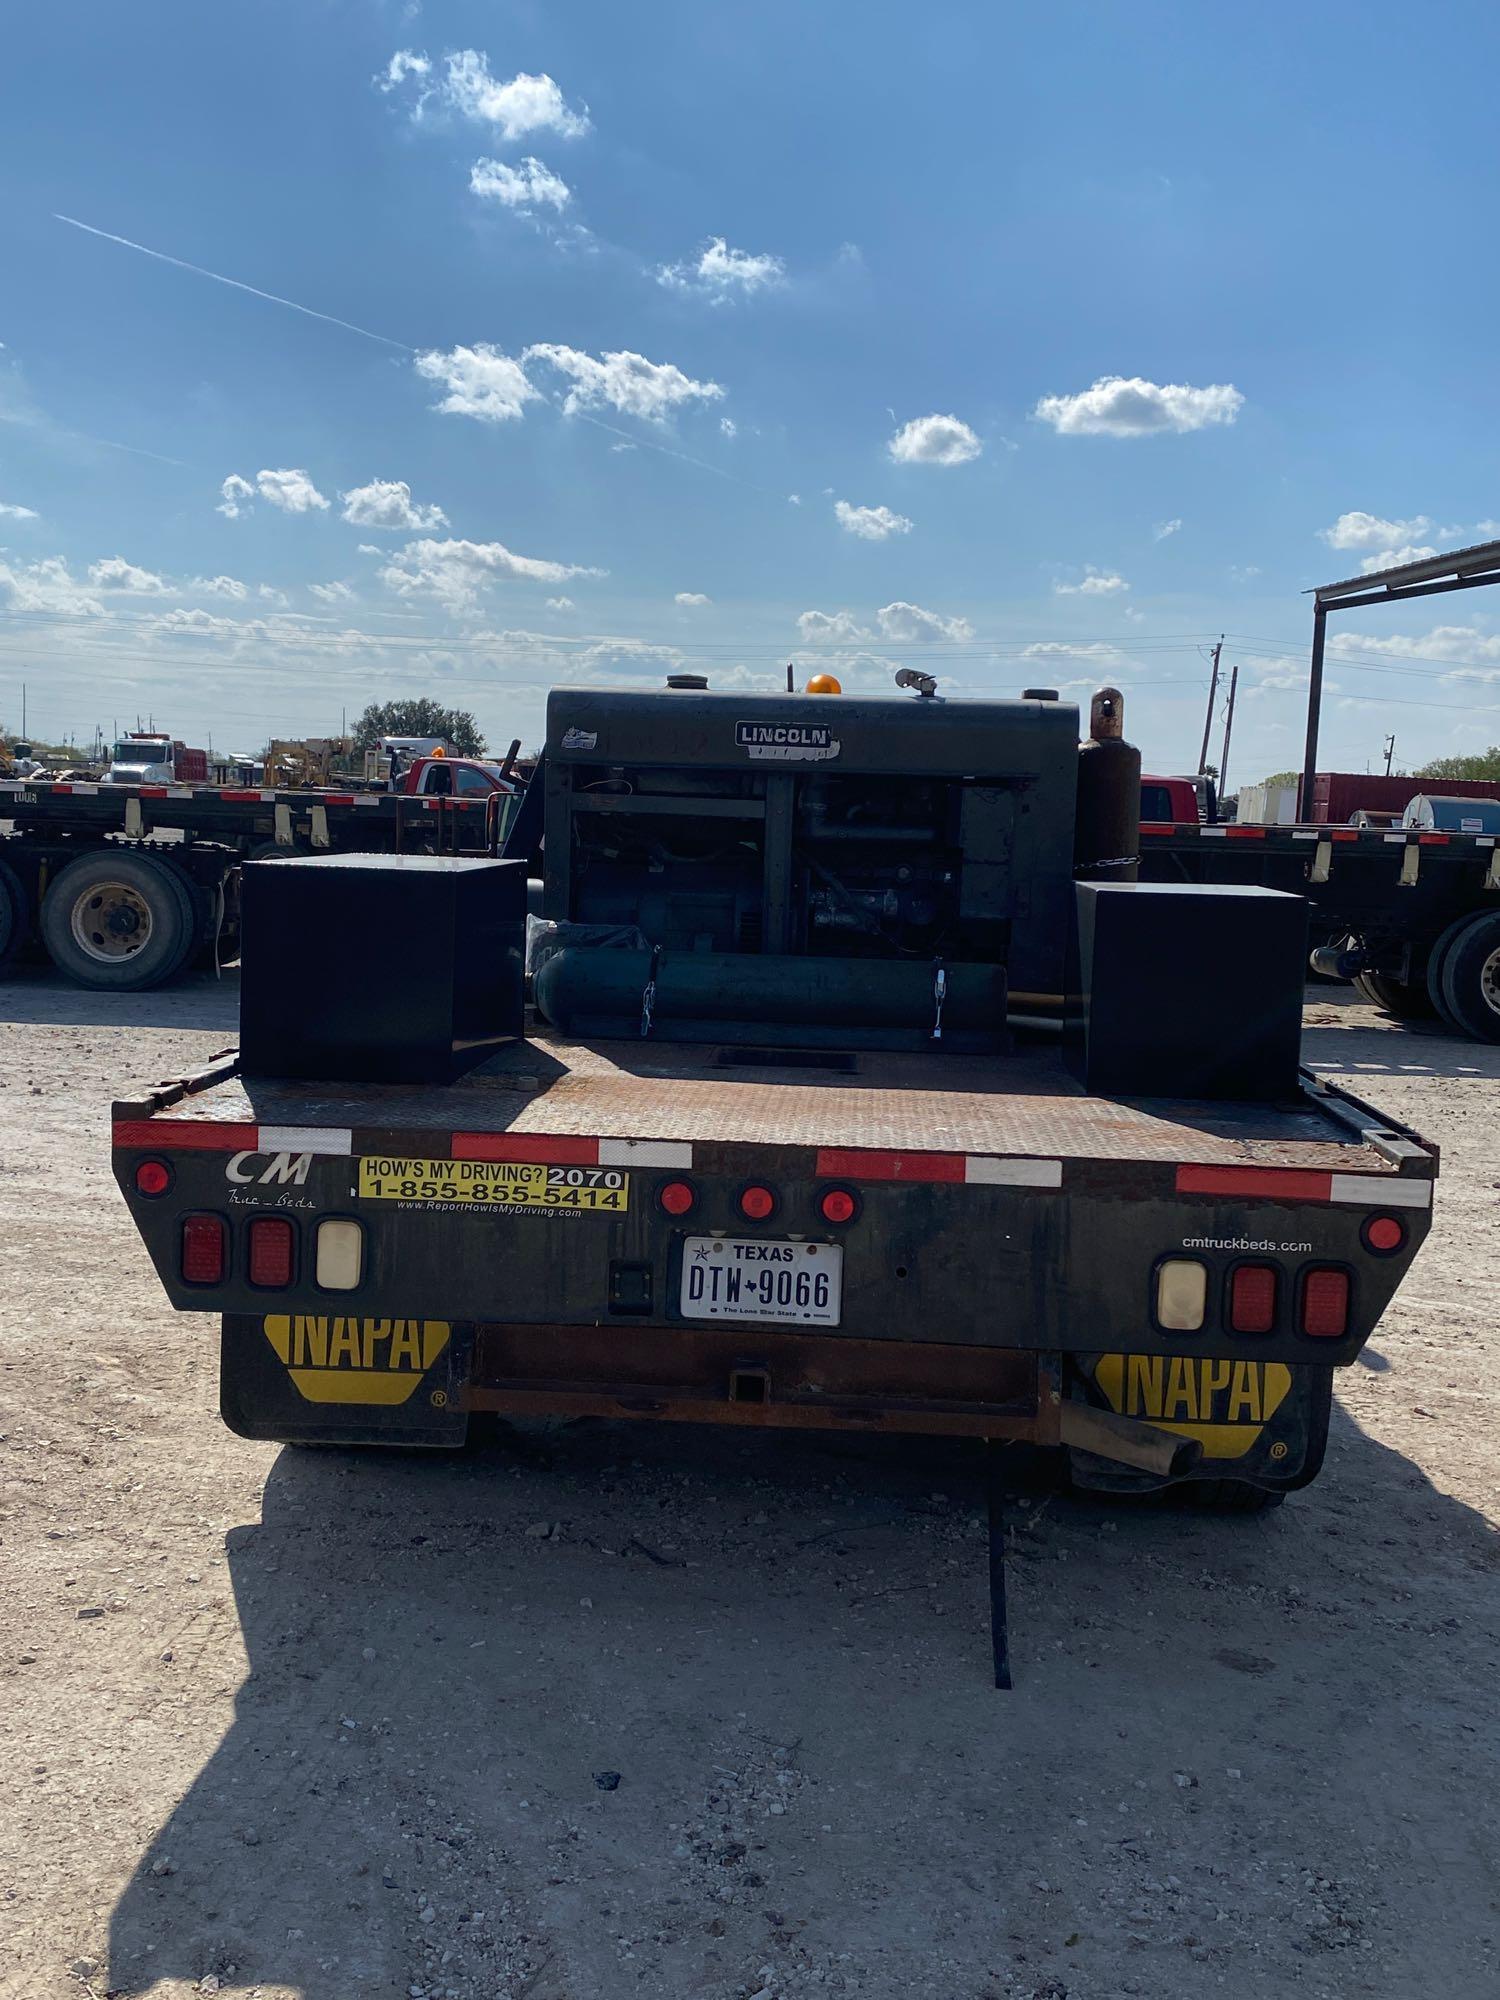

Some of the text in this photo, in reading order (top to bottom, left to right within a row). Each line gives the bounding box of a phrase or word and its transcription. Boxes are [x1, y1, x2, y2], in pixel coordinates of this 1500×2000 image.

[741, 727, 827, 744] LINCOLN
[225, 1150, 314, 1185] CM
[366, 1159, 543, 1183] HOW'S MY DRIVING?
[547, 1168, 623, 1189] 2070
[369, 1179, 621, 1209] 1-855-855-5414
[397, 1200, 582, 1218] www.ReportHowIsMyDriving.com
[733, 1244, 794, 1262] TEXAS
[1182, 1236, 1312, 1252] cmtruckbeds.com
[689, 1265, 829, 1308] DTW 9066
[293, 1314, 422, 1370] NAPA
[1126, 1354, 1262, 1421] NAPA
